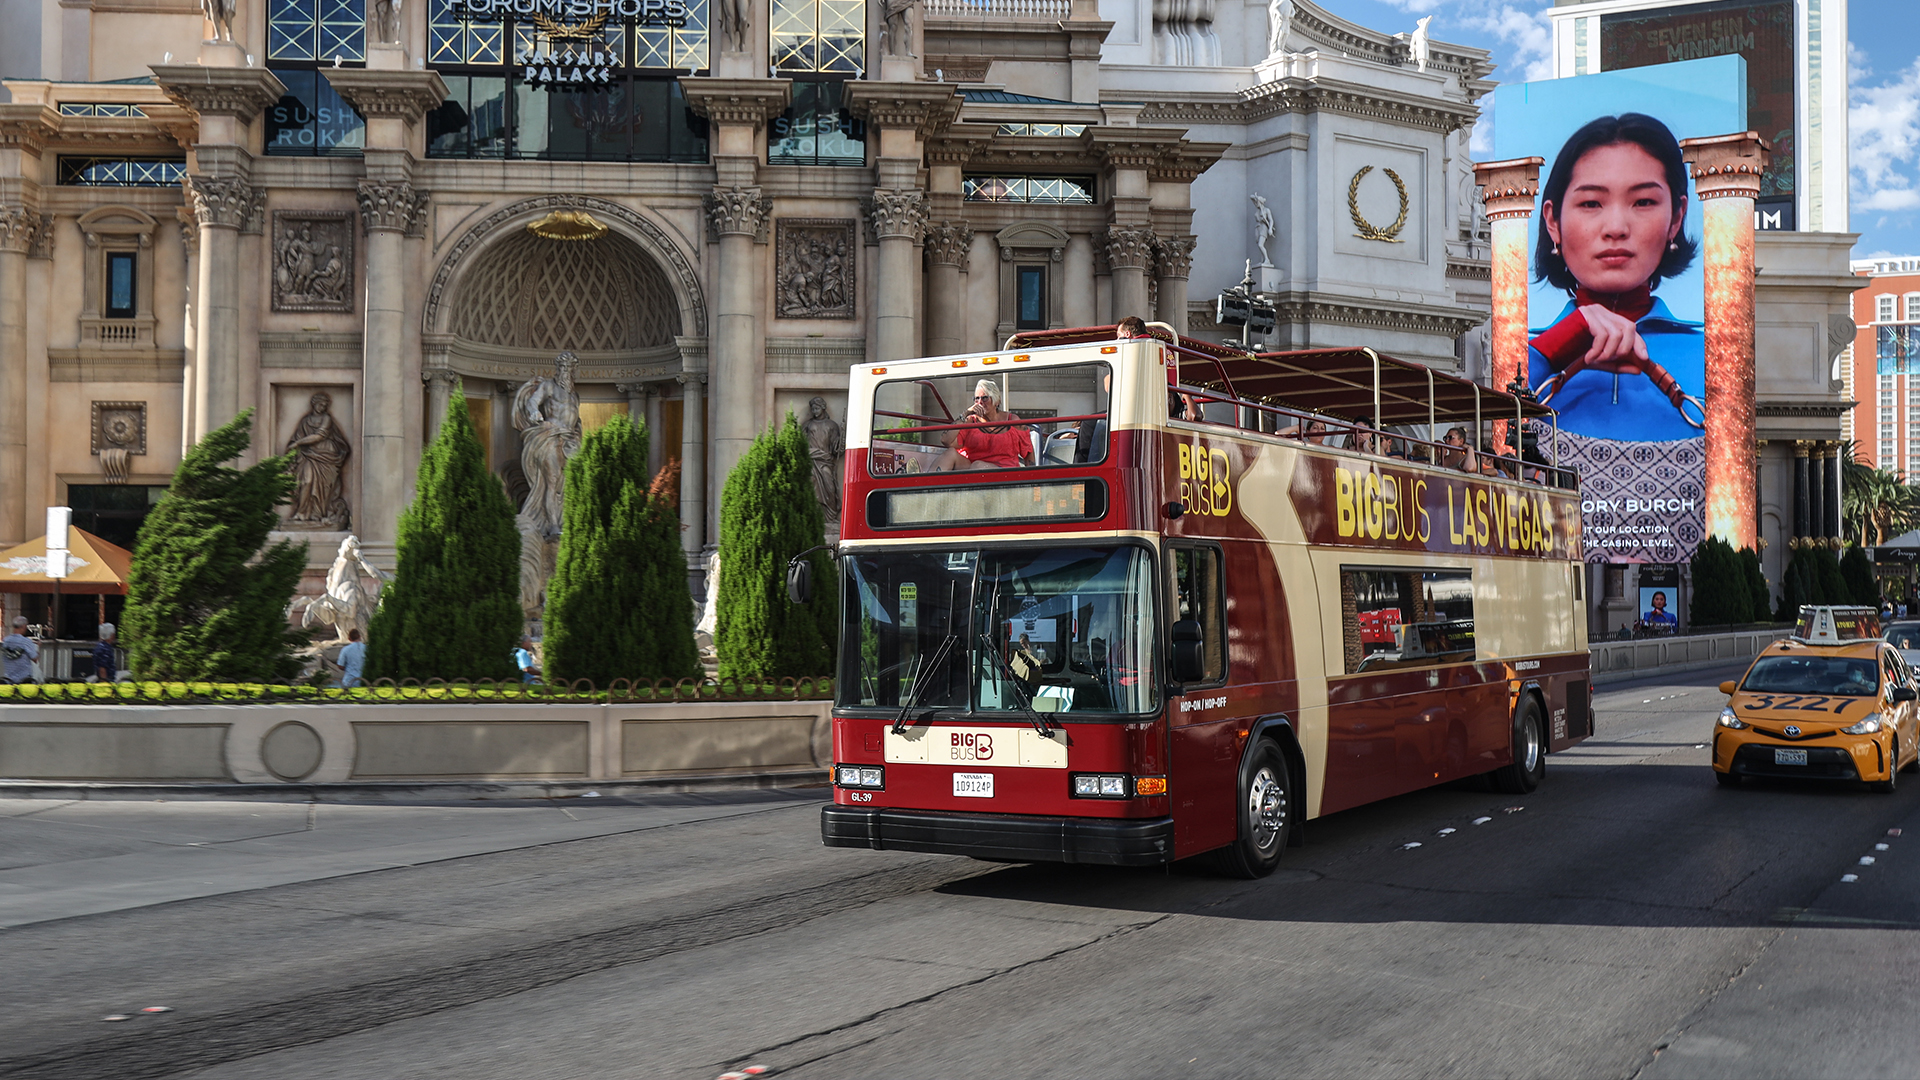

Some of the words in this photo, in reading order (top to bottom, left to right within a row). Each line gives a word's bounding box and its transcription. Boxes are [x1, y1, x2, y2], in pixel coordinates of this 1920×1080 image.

[572, 0, 686, 18] SHOPS
[1647, 22, 1706, 48] SEVEN
[1712, 16, 1744, 39] SIN
[1667, 31, 1755, 61] MINIMUM
[518, 49, 619, 66] CAESARS
[525, 66, 609, 82] PALACE
[273, 106, 354, 125] SUSH
[775, 117, 864, 135] SUSHI
[278, 128, 357, 146] ROKU
[780, 138, 856, 156] ROKU
[1179, 442, 1209, 481] BIG
[1180, 482, 1211, 516] BUS
[1581, 499, 1621, 513] ORY
[1626, 498, 1695, 512] BURCH
[1447, 484, 1490, 547] LAS
[1493, 491, 1554, 553] VEGAS
[1595, 525, 1616, 534] OUR
[1619, 525, 1670, 534] LOCATION
[1601, 539, 1640, 548] CASINO
[1642, 539, 1674, 547] LEVEL
[1180, 699, 1201, 712] HOP-ON
[1204, 696, 1227, 709] HOP-OFF
[1744, 694, 1858, 714] 3227
[951, 733, 974, 747] BIG
[951, 747, 974, 760] BUS
[956, 780, 991, 792] 109124P
[851, 792, 872, 802] GL-39
